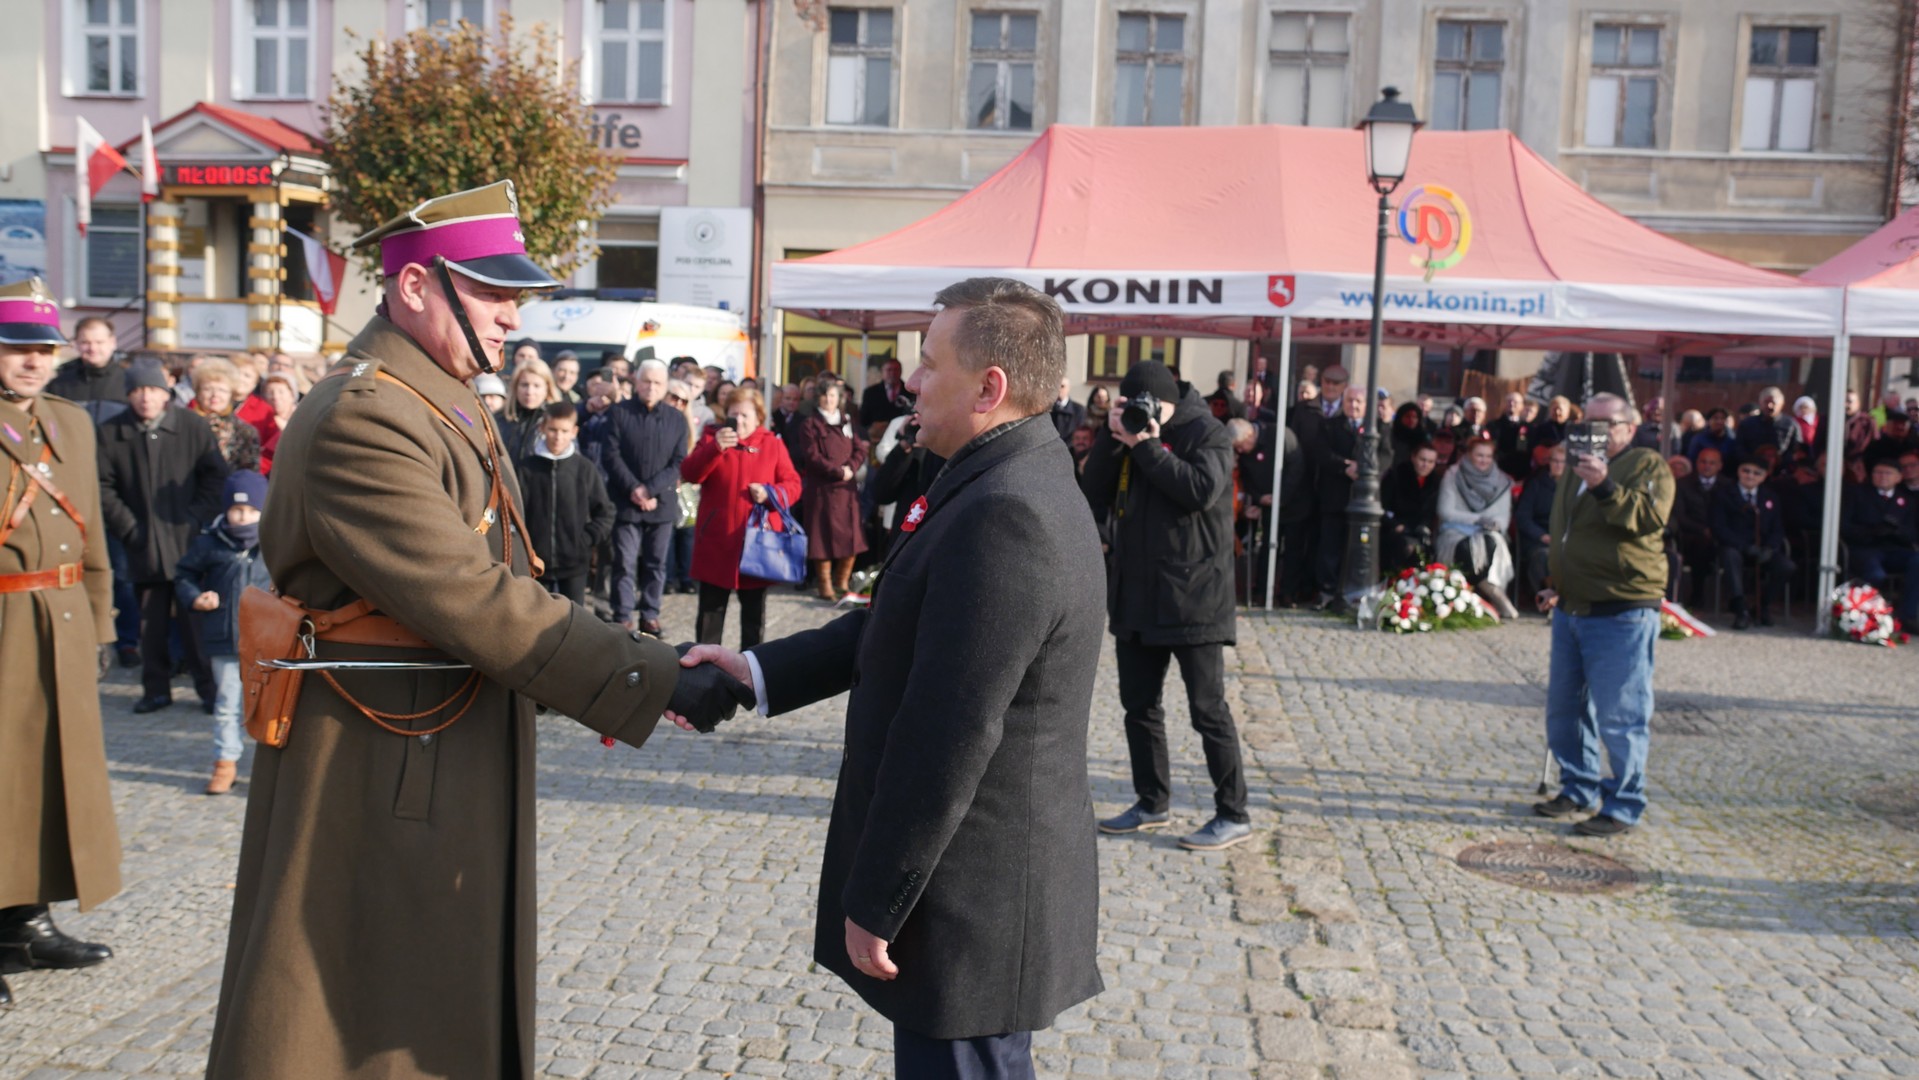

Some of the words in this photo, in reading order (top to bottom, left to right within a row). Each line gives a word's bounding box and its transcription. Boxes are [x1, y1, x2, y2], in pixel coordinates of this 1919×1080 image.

[591, 113, 642, 148] ife
[1044, 277, 1222, 304] KONIN
[1339, 288, 1546, 317] www.konin.pl
